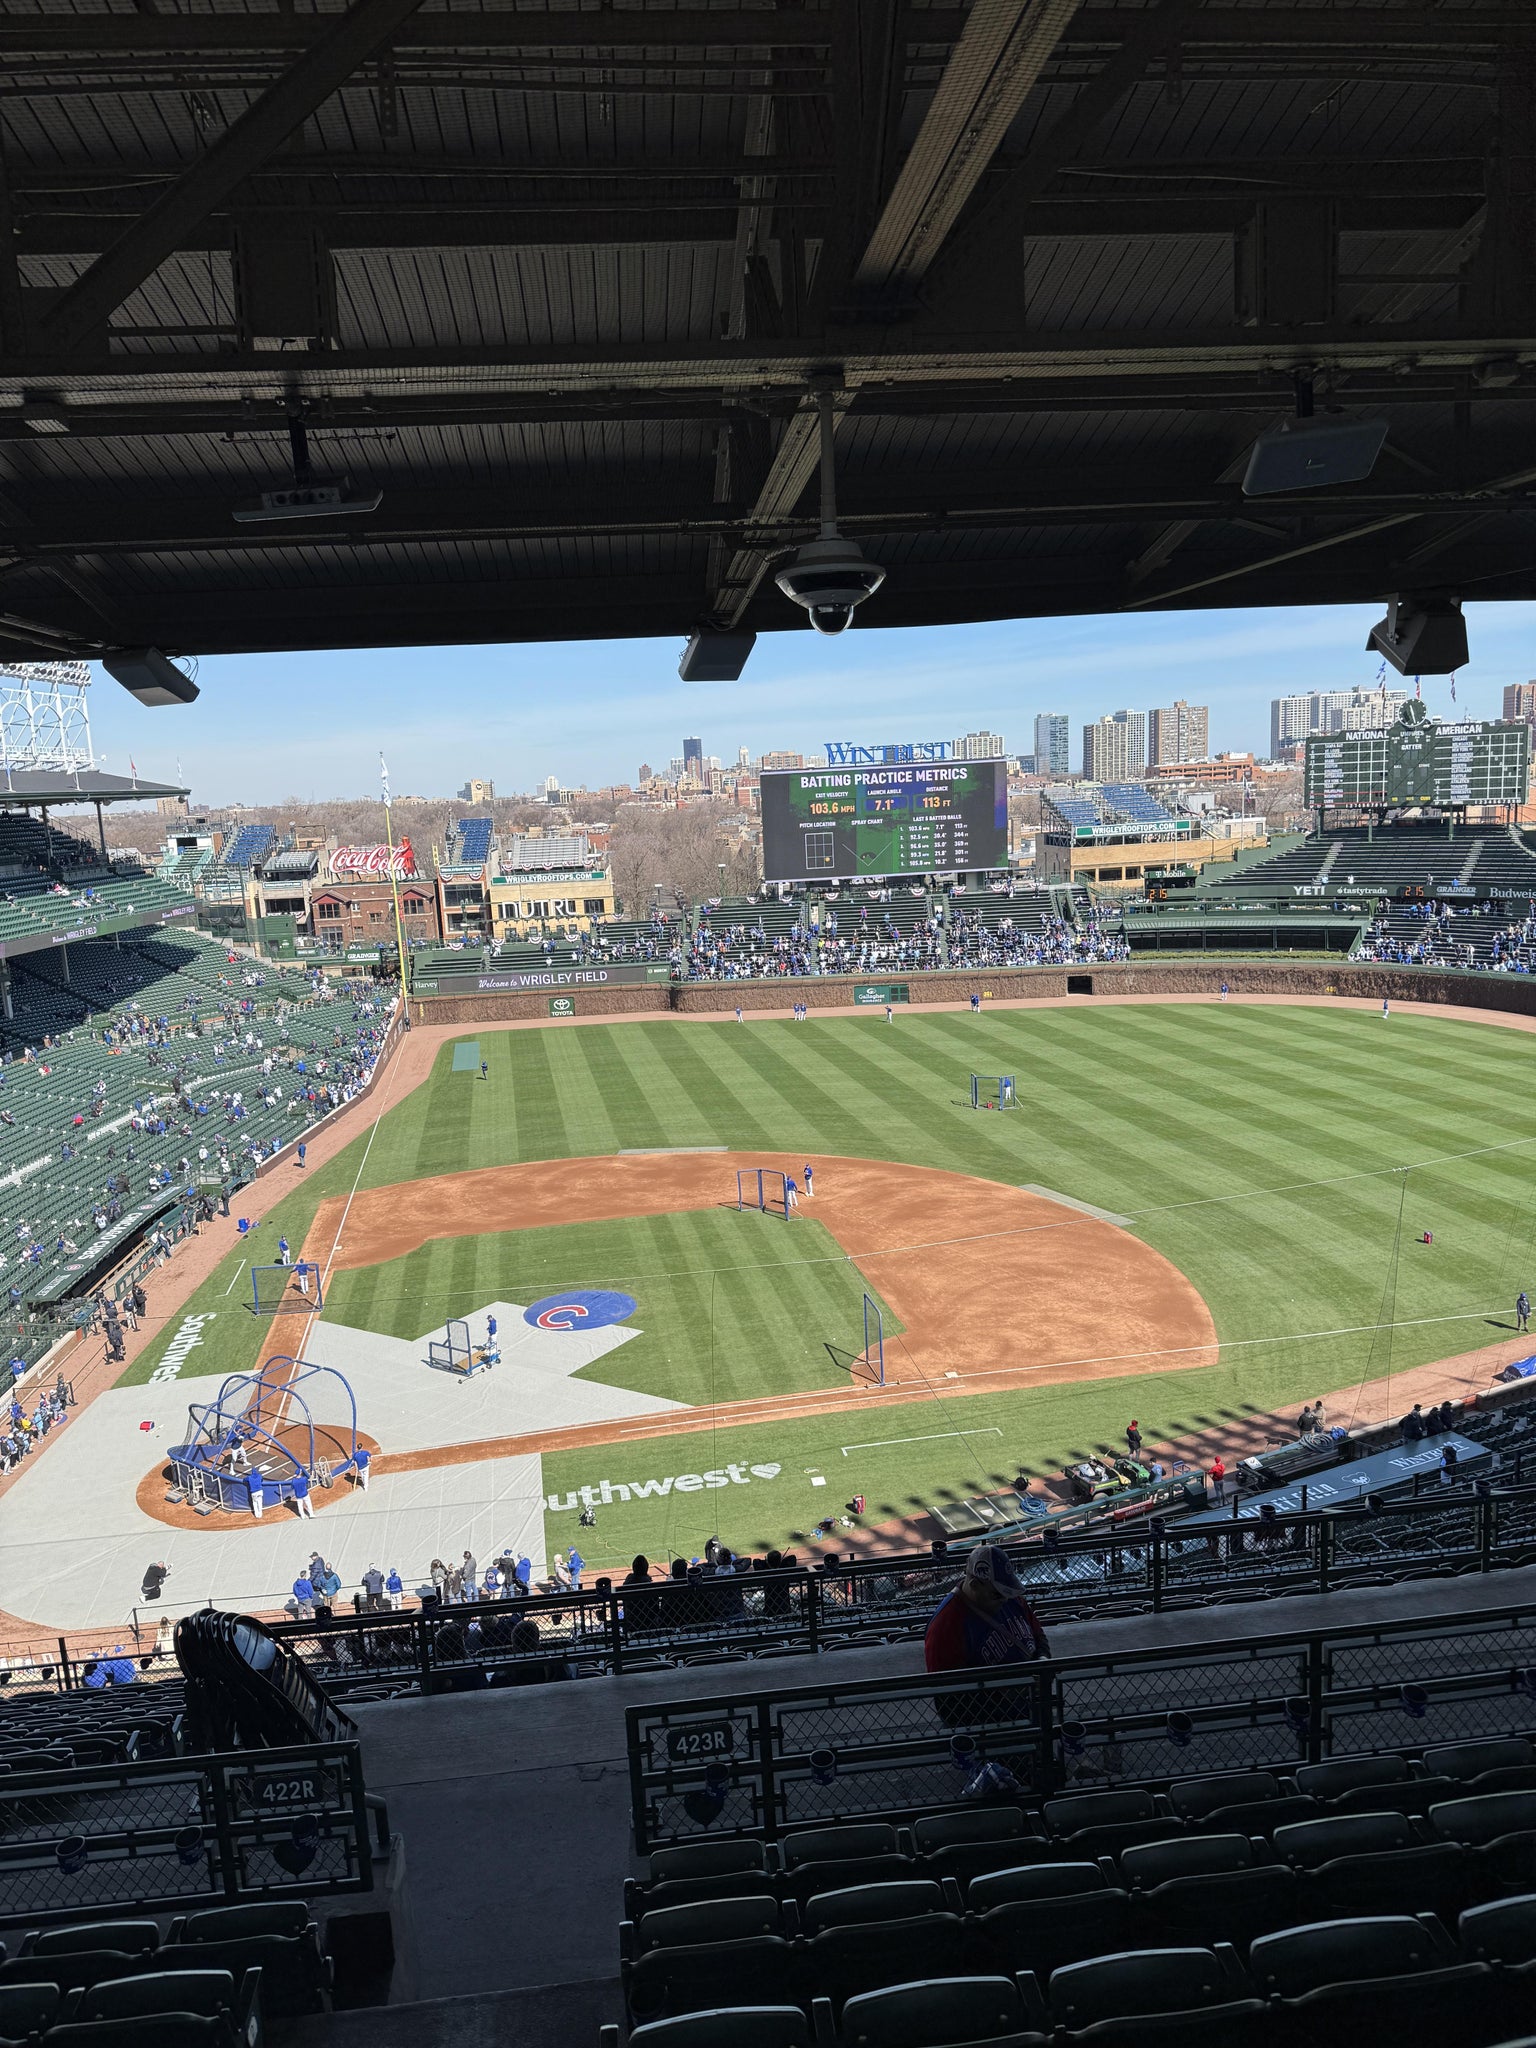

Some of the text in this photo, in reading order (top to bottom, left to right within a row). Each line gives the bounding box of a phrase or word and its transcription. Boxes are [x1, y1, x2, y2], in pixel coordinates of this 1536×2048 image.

[1346, 730, 1389, 740] NATIONAL
[1436, 726, 1482, 736] AMERICAN
[824, 742, 951, 764] WINTRUST
[801, 768, 967, 788] BATTING PRACTICE METRICS
[810, 802, 838, 814] 103.6
[875, 800, 894, 810] 7.1°
[923, 797, 940, 808] 113
[329, 844, 410, 874] Coca-Cola
[1293, 886, 1326, 896] YETI
[1344, 887, 1388, 895] tastytrade
[479, 979, 509, 988] Welcome
[520, 973, 572, 985] WRIGLEY
[575, 971, 607, 982] FIELD
[541, 1464, 751, 1512] uthwest
[676, 1731, 726, 1754] 423R
[263, 1780, 315, 1802] 422R
